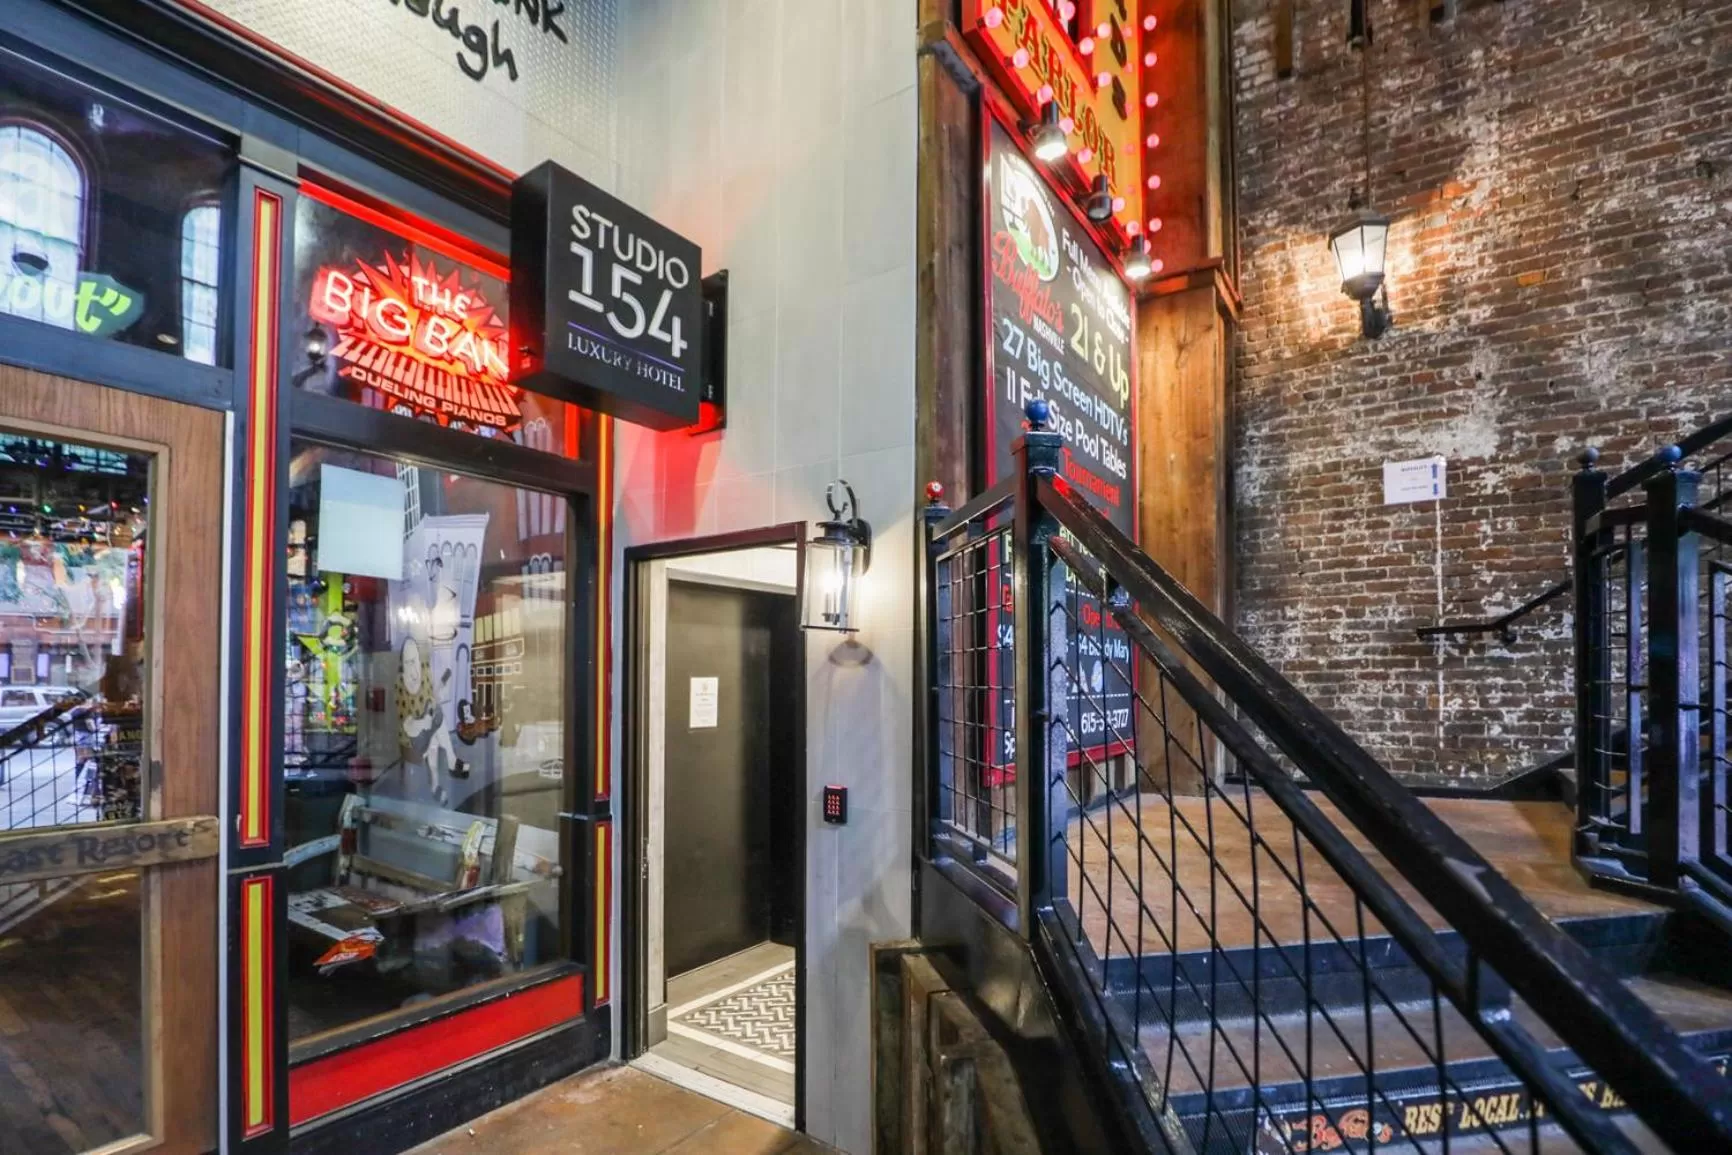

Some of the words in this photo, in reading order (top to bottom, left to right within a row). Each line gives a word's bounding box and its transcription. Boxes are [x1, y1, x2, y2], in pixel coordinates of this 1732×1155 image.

[570, 204, 690, 289] STUDIO
[319, 268, 412, 343] BIG
[420, 314, 511, 379] BAN
[410, 275, 472, 320] THE
[567, 241, 688, 359] 154
[350, 366, 437, 409] DUELING
[440, 402, 508, 427] PIANOS
[567, 332, 632, 371] LUXURY
[636, 360, 686, 393] HOTEL
[1003, 317, 1024, 360] 27
[1027, 338, 1050, 390] Big
[1053, 361, 1092, 419] Screen
[1070, 303, 1089, 362] 21
[1109, 344, 1129, 409] Up
[1048, 399, 1073, 442] Size
[1075, 418, 1099, 461] Pool
[1100, 435, 1127, 479] Tables
[76, 832, 189, 868] Resort
